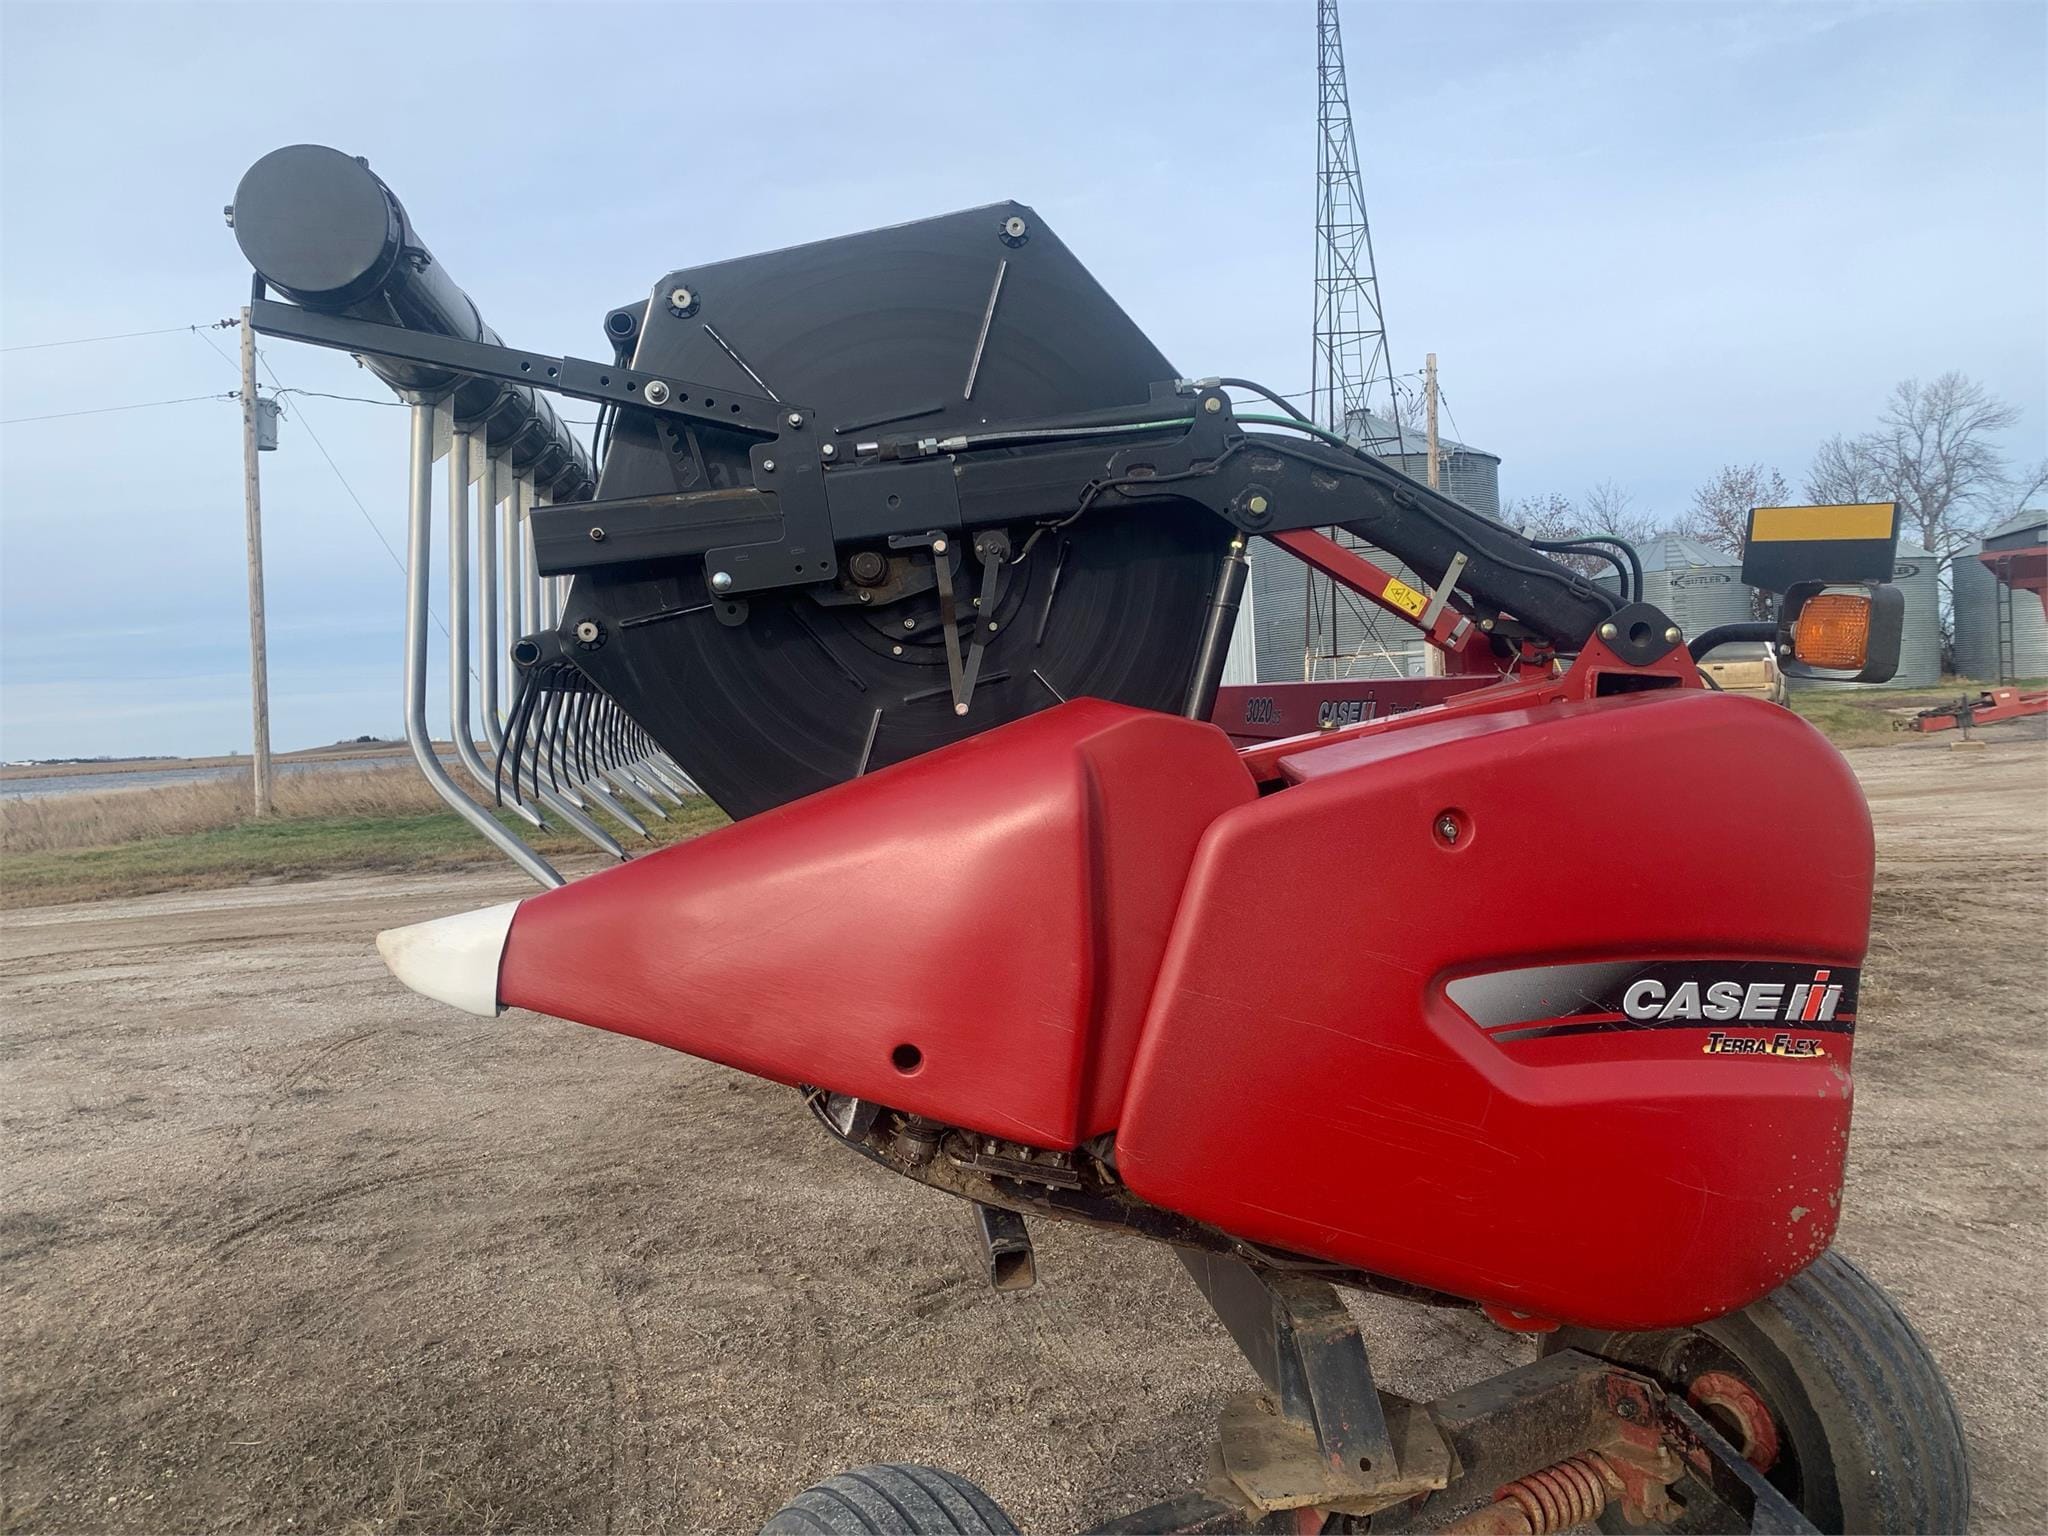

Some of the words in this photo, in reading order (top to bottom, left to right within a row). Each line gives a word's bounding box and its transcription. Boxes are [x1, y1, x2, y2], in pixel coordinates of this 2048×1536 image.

[1246, 697, 1274, 724] 3020
[1318, 700, 1360, 724] CASE
[1623, 979, 1785, 1021] CASE
[1706, 1031, 1767, 1055] TERRA
[1771, 1033, 1821, 1055] FLEX
